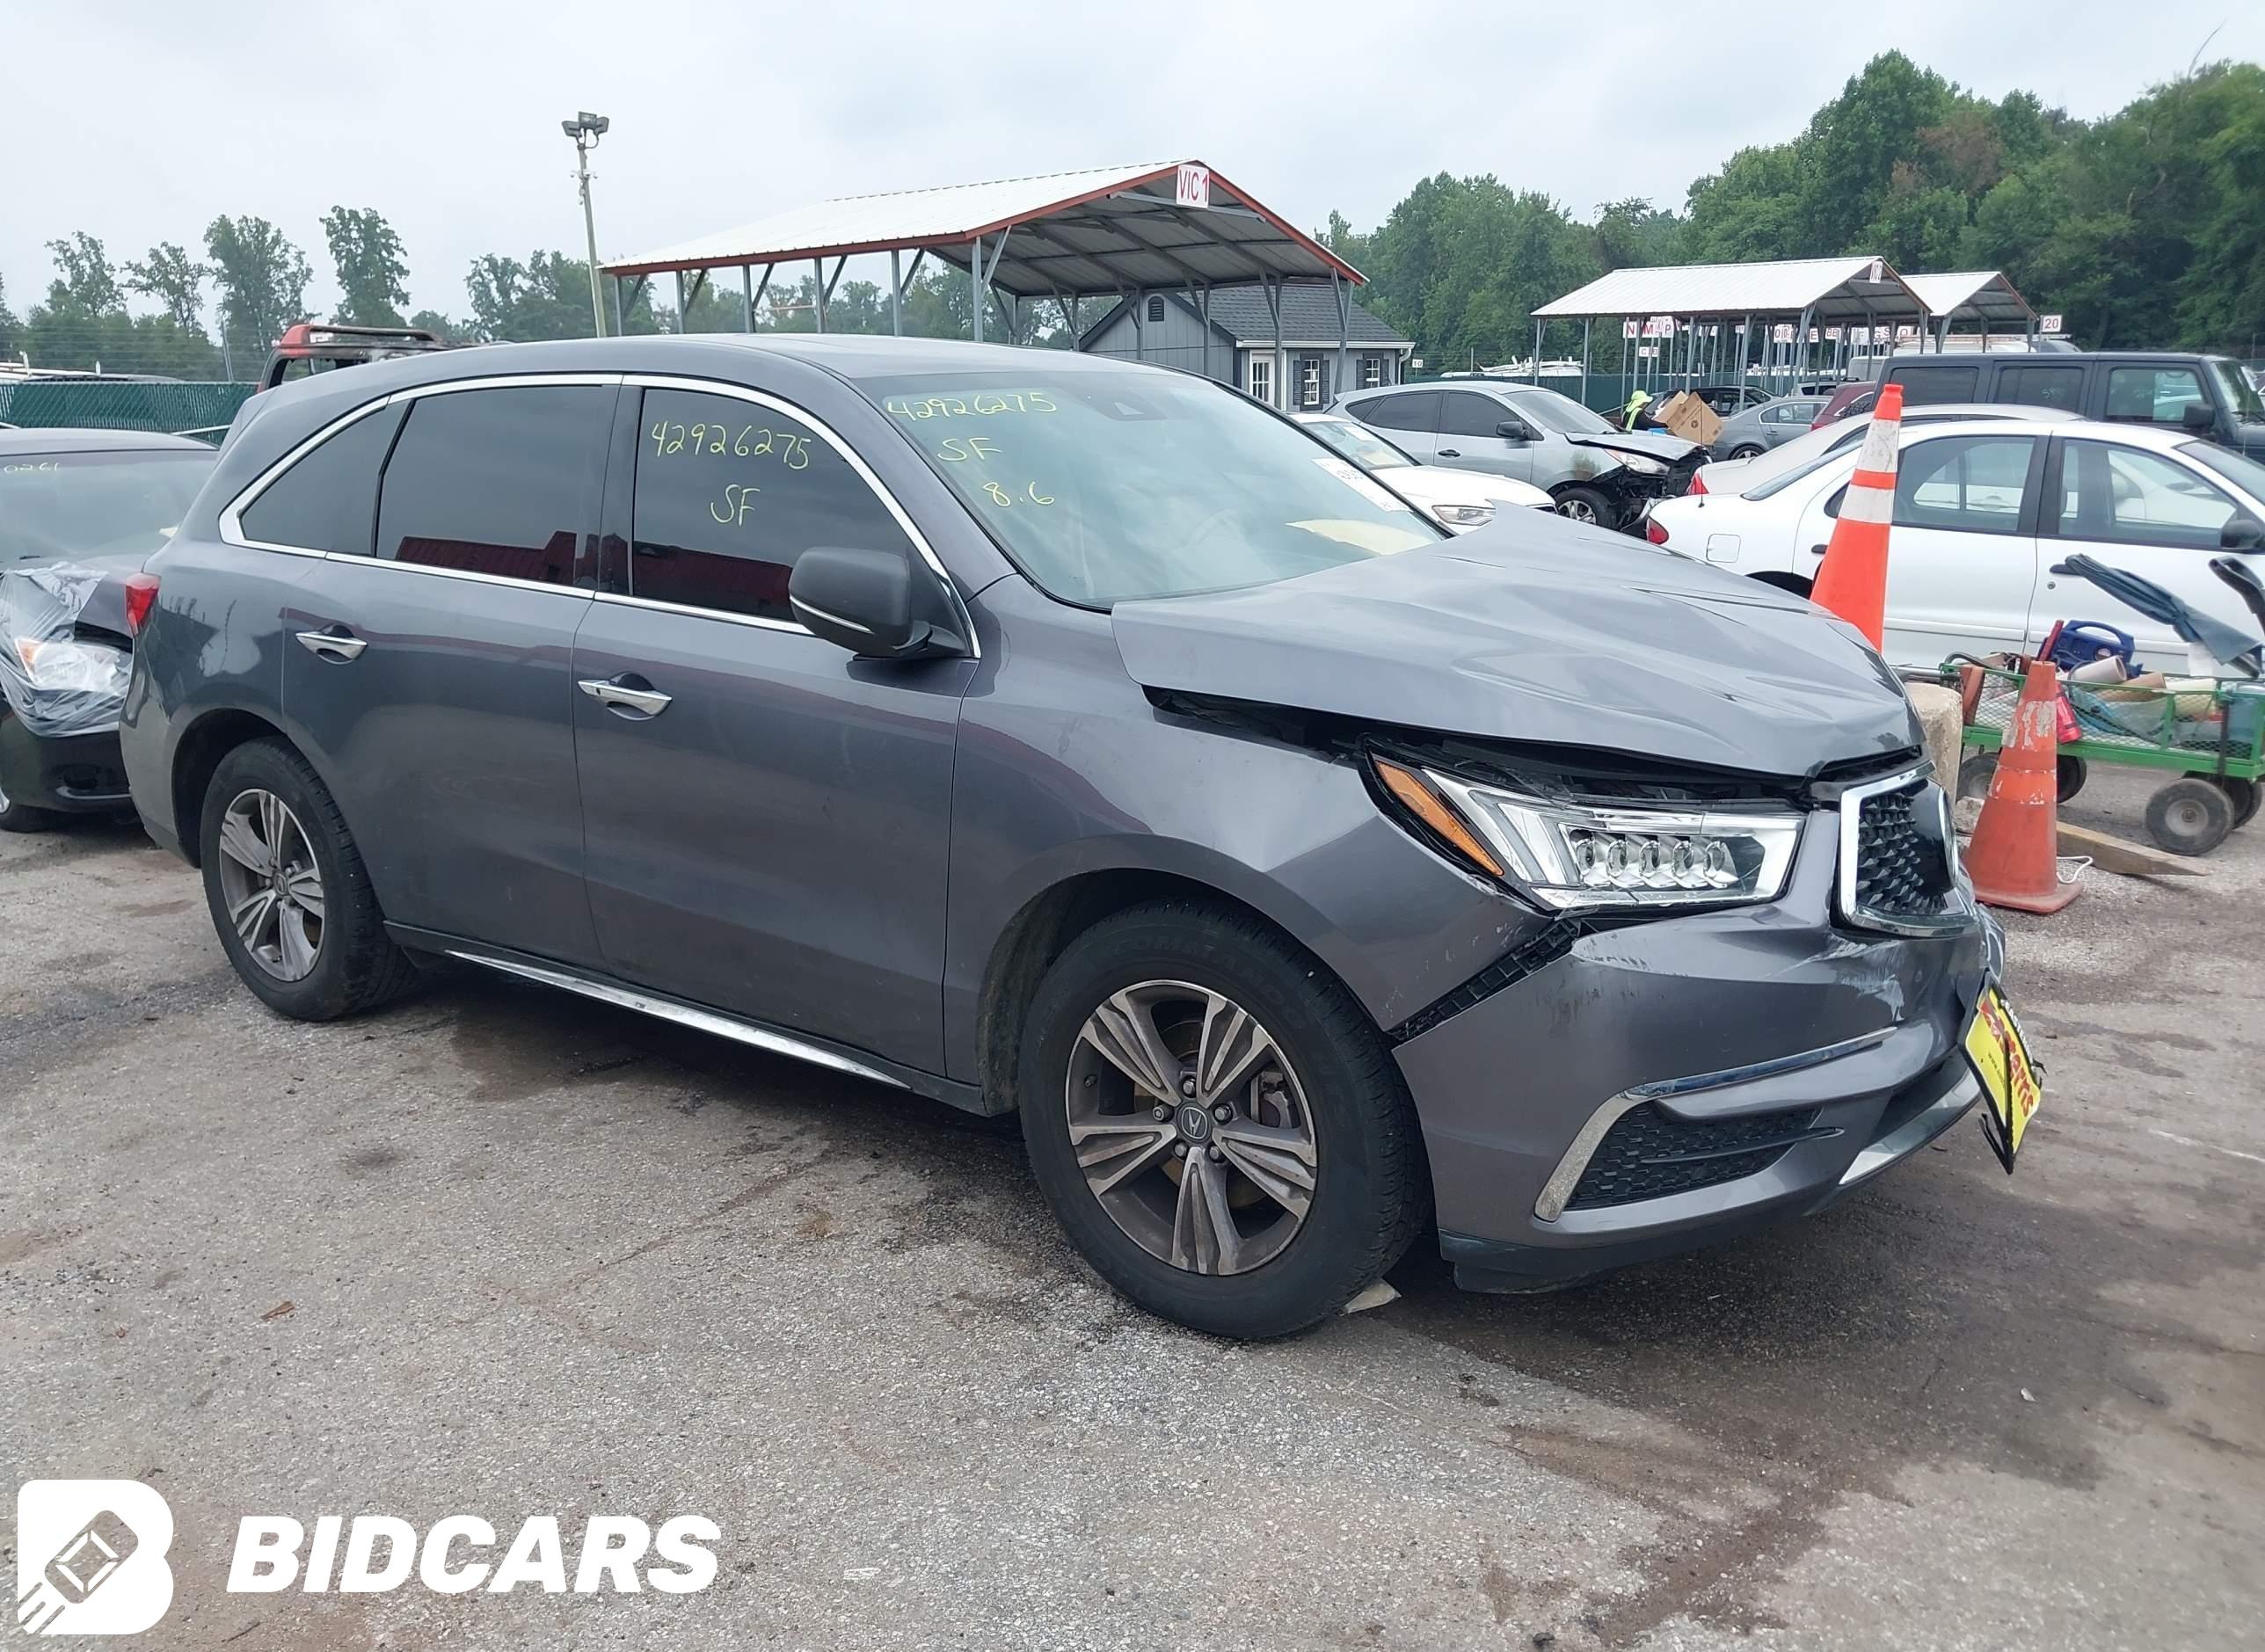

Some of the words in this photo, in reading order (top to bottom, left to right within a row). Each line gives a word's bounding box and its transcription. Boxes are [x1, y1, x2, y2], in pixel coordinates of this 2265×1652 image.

[1179, 169, 1199, 201] VIC
[1202, 173, 1208, 203] 1
[1627, 324, 1635, 336] N
[1642, 324, 1654, 335] M
[2044, 317, 2058, 329] 20
[886, 392, 1057, 421] 42926275
[652, 421, 812, 469] 42926275
[937, 437, 1003, 461] SF
[710, 484, 761, 527] SF
[982, 481, 1055, 506] 8.6
